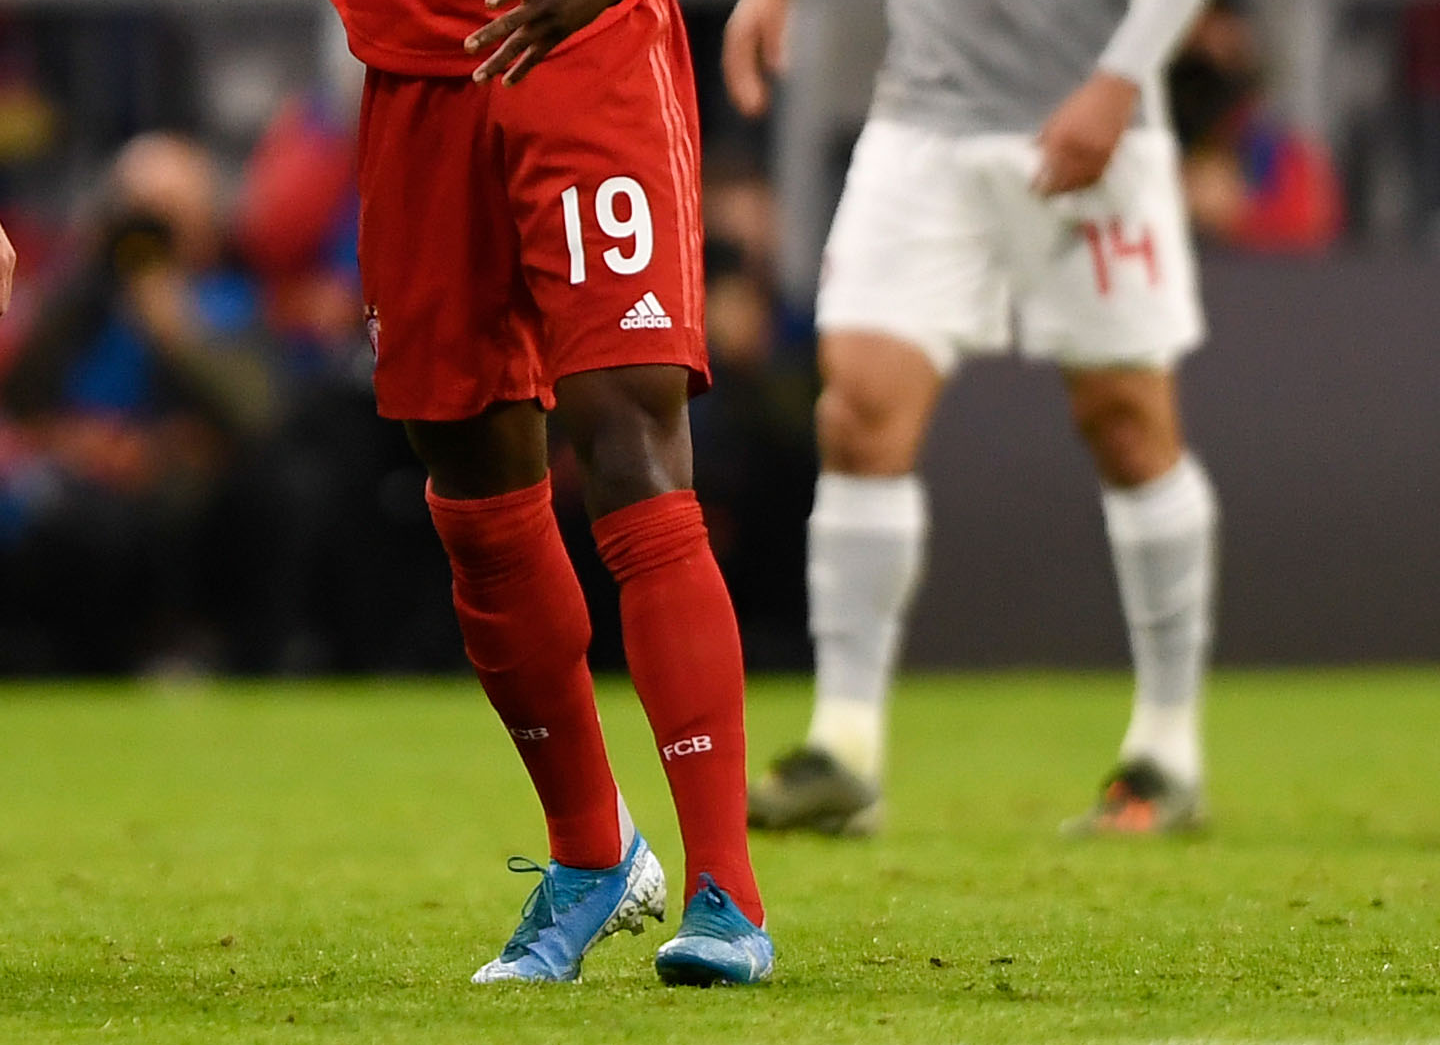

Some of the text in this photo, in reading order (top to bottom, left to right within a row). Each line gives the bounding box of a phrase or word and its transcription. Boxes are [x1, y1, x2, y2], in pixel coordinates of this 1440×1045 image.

[561, 176, 653, 284] 19
[1078, 214, 1164, 296] 14
[620, 315, 672, 330] adidas
[663, 735, 712, 761] FCB
